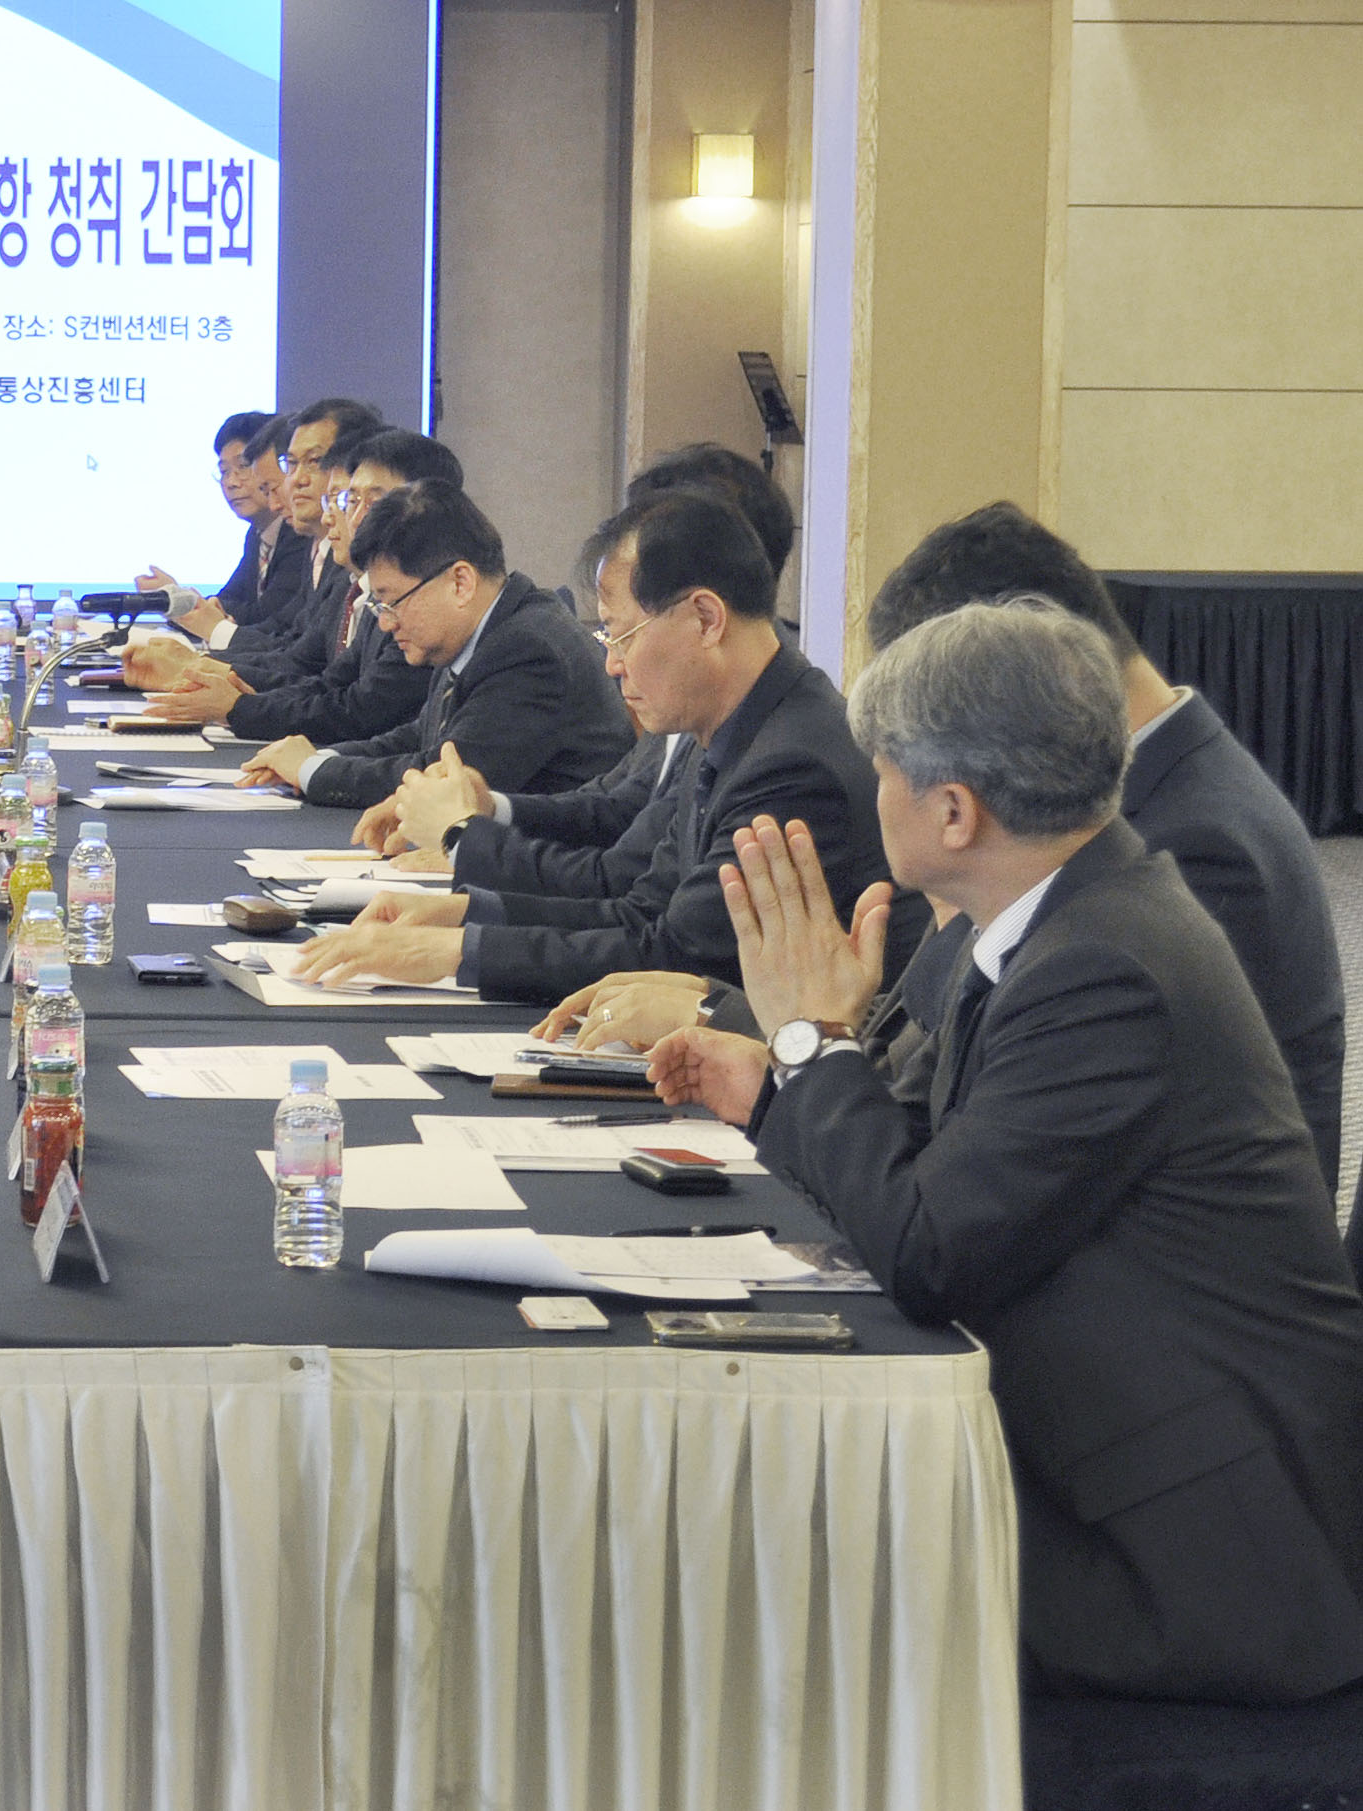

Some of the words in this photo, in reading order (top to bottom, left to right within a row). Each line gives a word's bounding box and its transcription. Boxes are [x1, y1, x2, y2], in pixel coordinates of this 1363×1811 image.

[47, 157, 122, 269] 청취
[140, 157, 255, 267] 간담회
[2, 314, 54, 341] 장소:
[64, 314, 189, 342] S컨벤션센터
[197, 315, 234, 343] 3층
